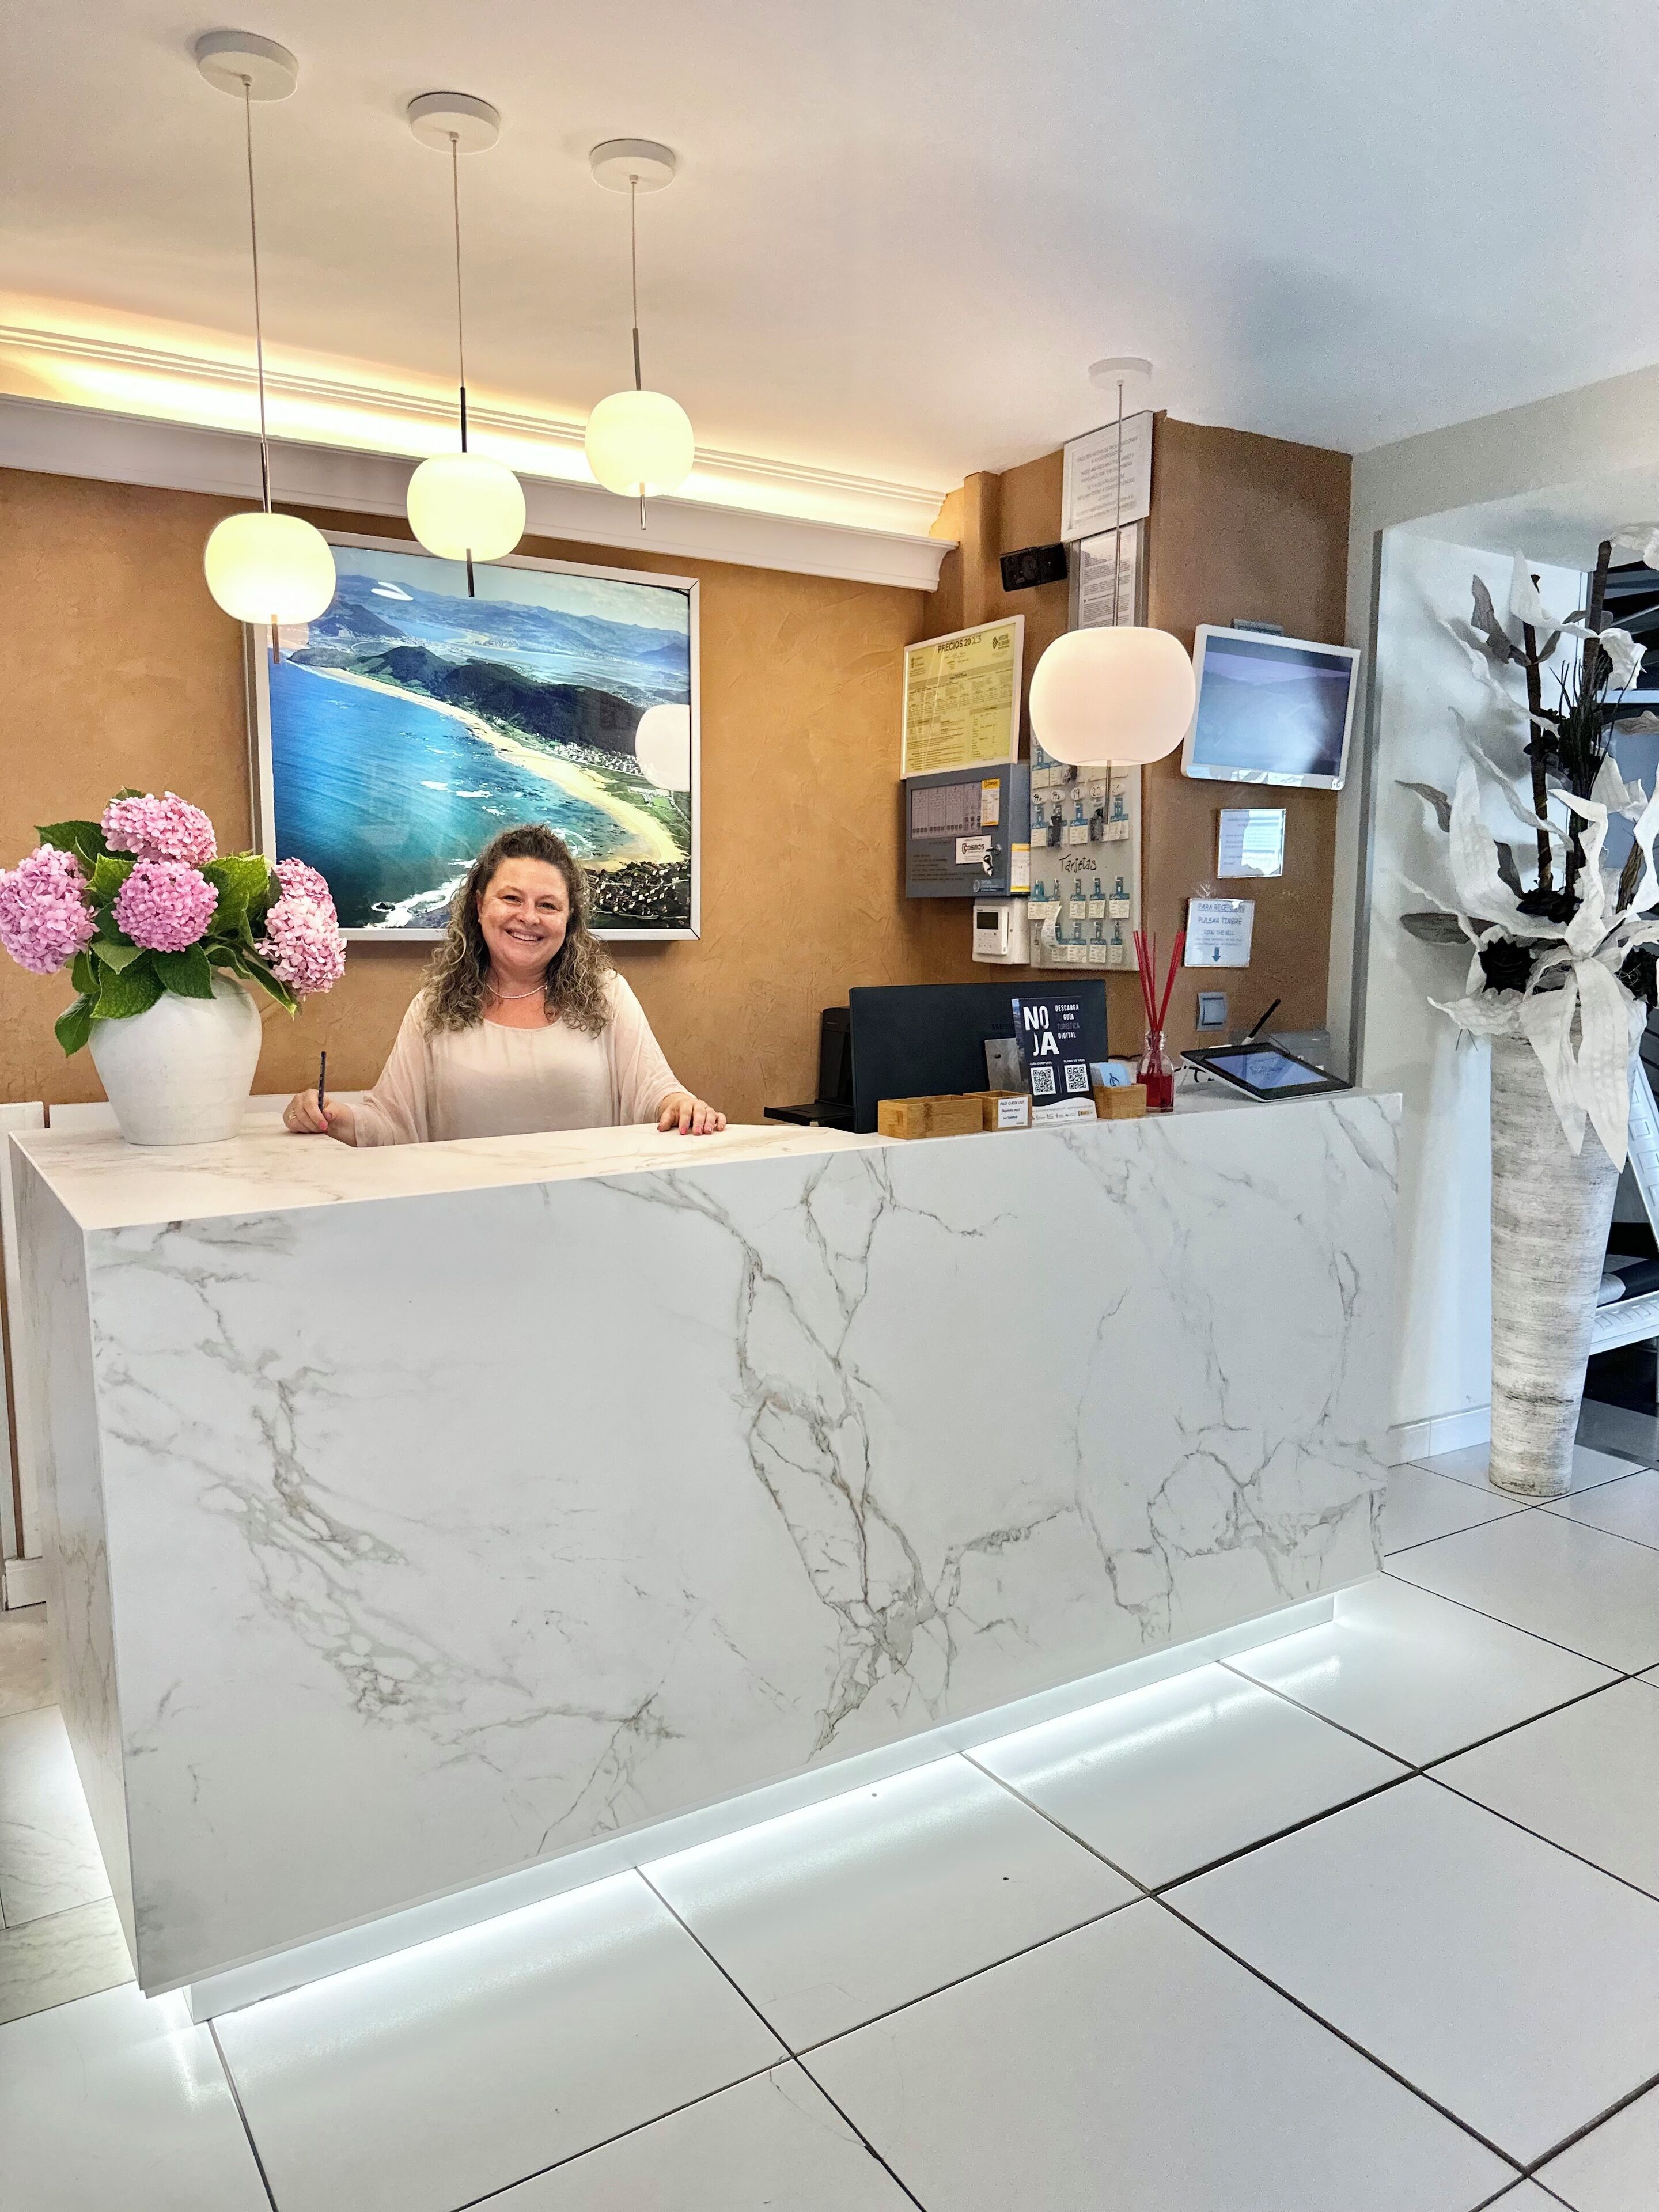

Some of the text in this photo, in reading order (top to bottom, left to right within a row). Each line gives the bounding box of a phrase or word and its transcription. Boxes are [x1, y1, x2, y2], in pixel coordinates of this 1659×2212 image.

[938, 641, 963, 653] PRECIOS
[1073, 788, 1080, 799] 19
[1092, 786, 1101, 796] 20
[963, 843, 985, 853] COSMOS
[1059, 854, 1097, 873] Tarjetas
[1023, 1006, 1050, 1031] NO
[1033, 1031, 1060, 1056] JA
